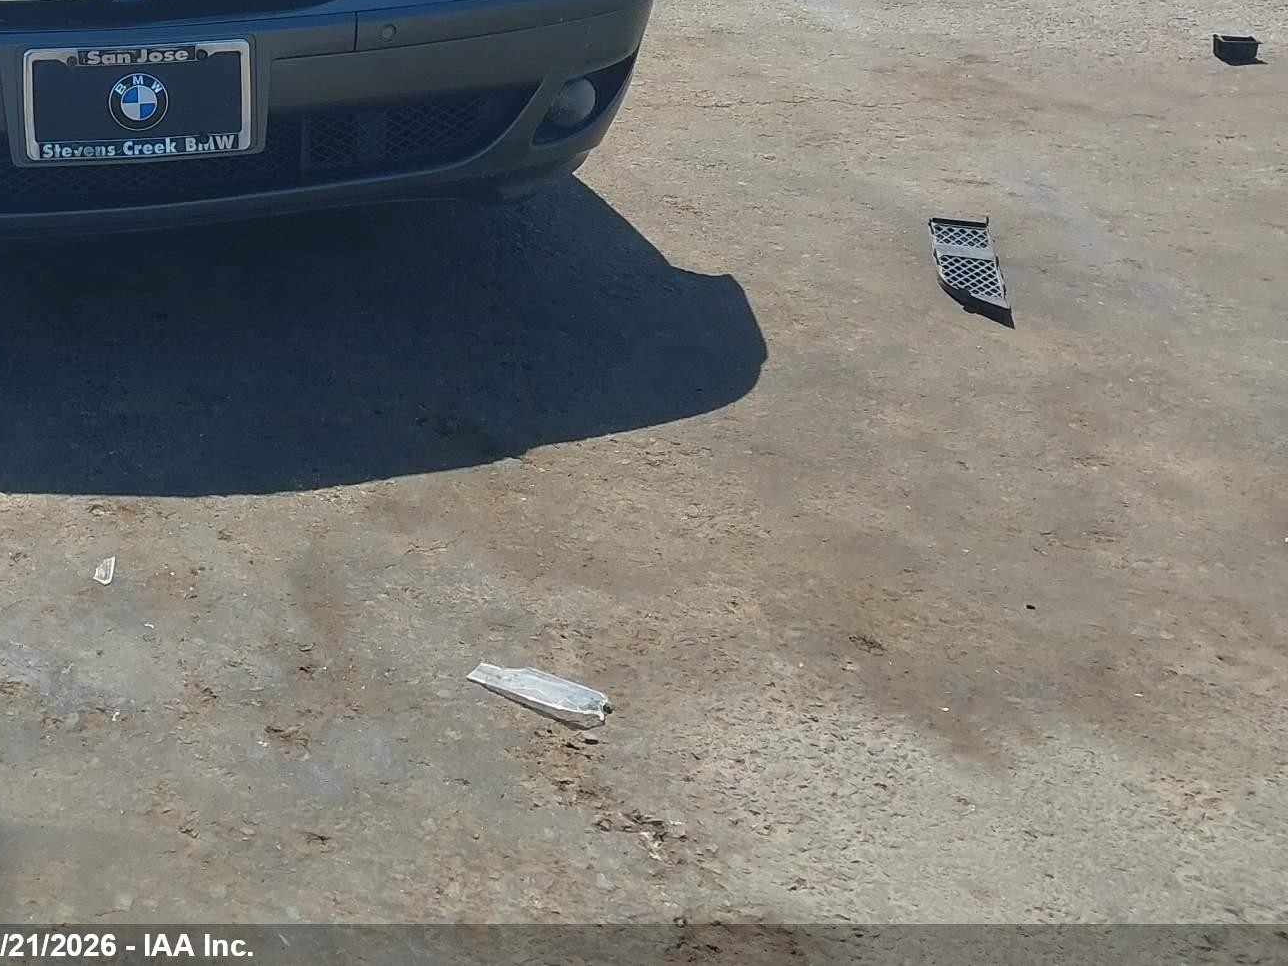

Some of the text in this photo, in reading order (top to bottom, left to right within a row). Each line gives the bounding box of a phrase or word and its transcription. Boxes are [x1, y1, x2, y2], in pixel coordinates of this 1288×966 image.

[86, 48, 190, 66] San Jose
[114, 75, 163, 95] BMW
[42, 143, 116, 159] Stevens
[122, 137, 178, 155] Creek
